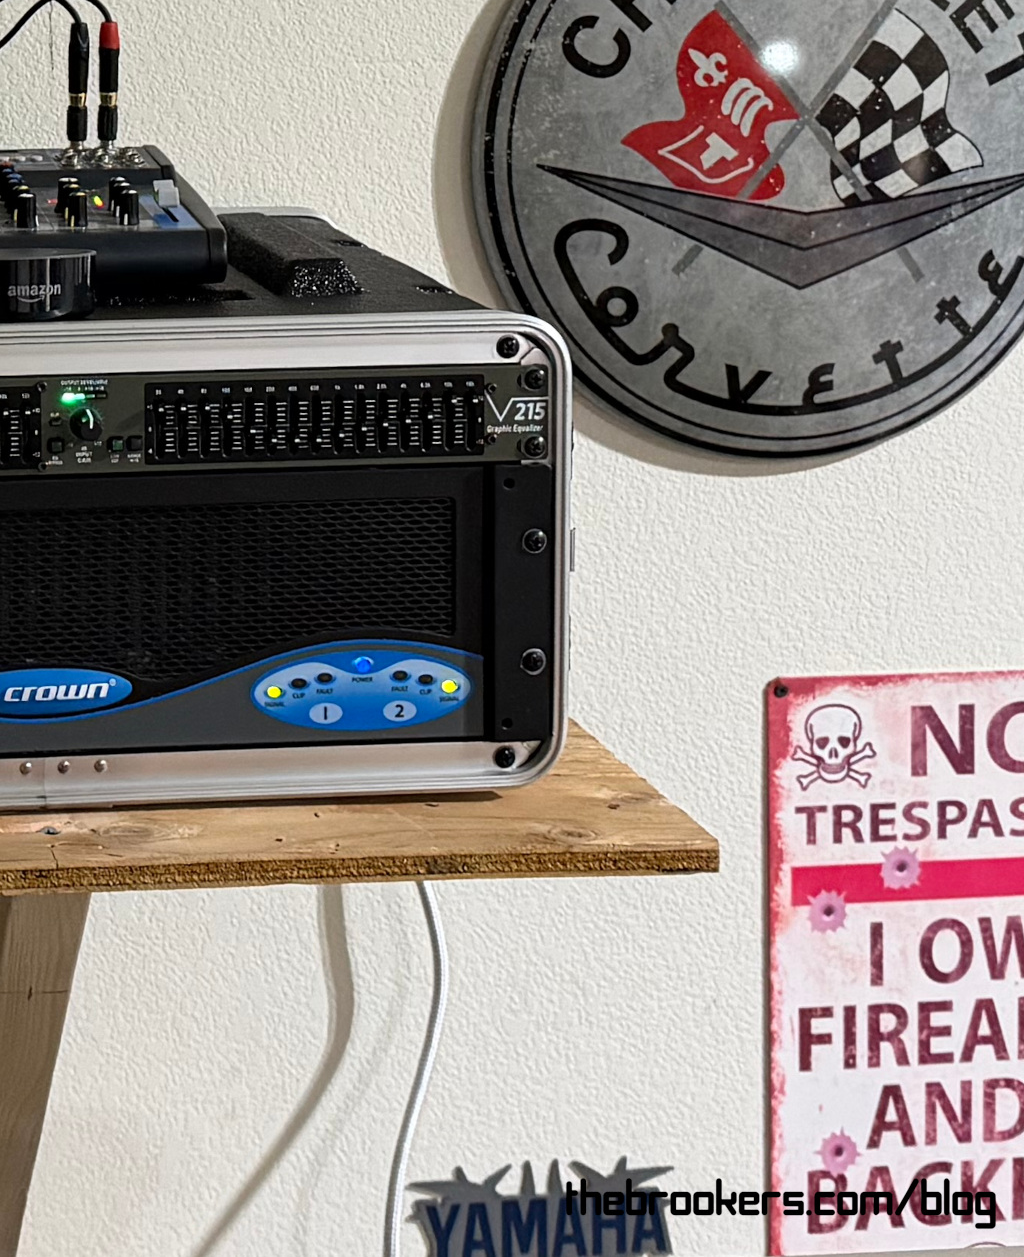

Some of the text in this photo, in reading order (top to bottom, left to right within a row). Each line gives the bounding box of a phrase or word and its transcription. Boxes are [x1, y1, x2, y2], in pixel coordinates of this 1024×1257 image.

[7, 284, 61, 297] amazon
[486, 424, 544, 434] Graphic Equalizer
[394, 704, 404, 718] 2
[869, 921, 884, 987] I
[797, 995, 1024, 1071] FIREA
[866, 1077, 1024, 1150] AND
[426, 1190, 667, 1257] YAMAHA
[806, 1156, 1024, 1235] BACK
